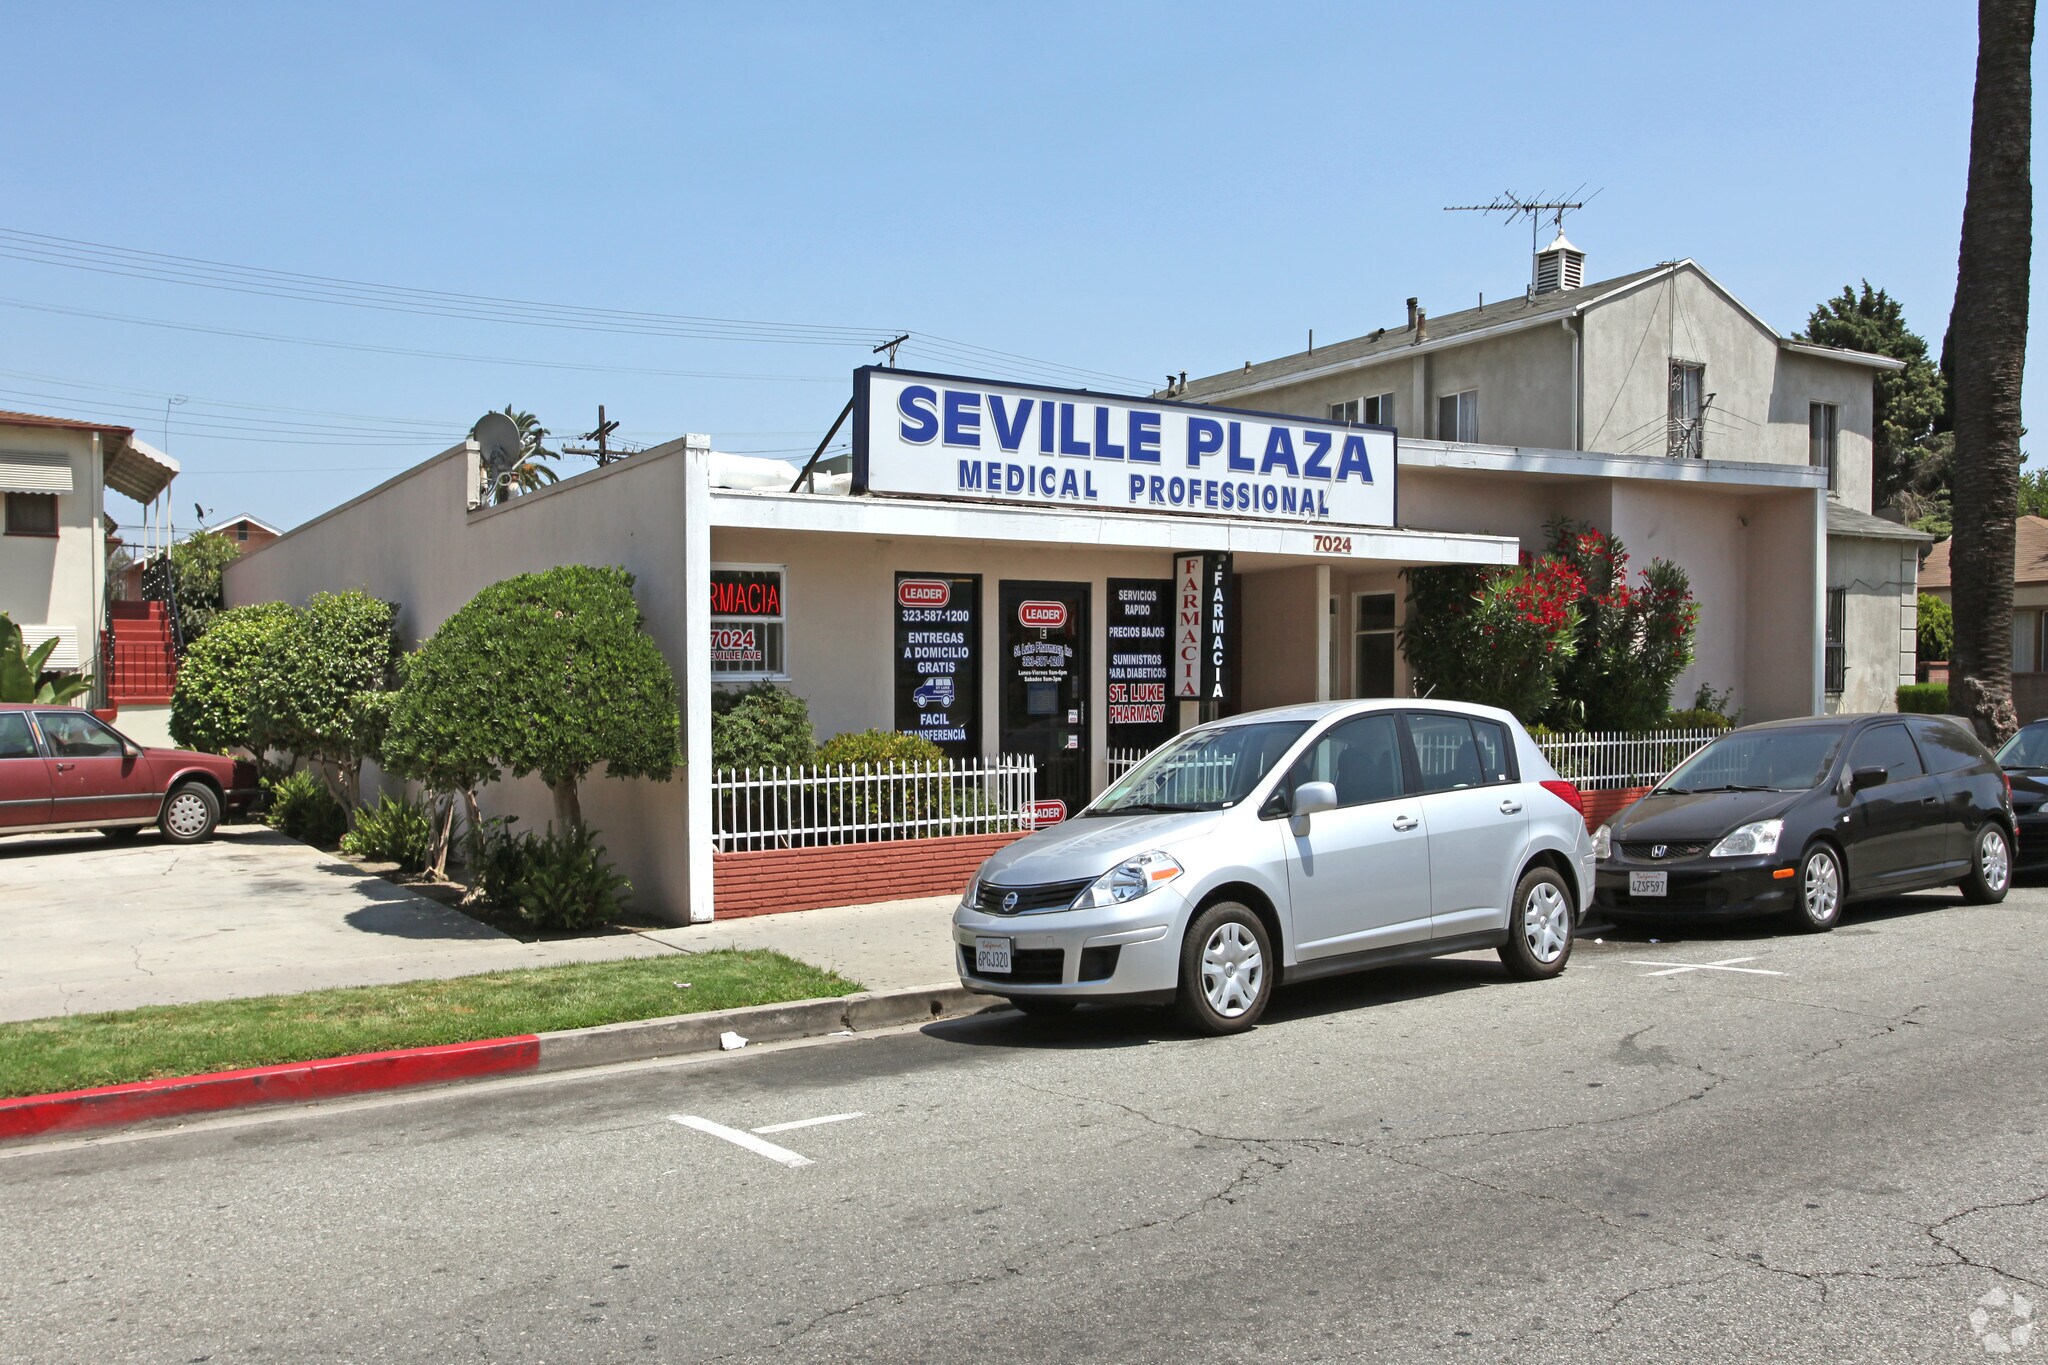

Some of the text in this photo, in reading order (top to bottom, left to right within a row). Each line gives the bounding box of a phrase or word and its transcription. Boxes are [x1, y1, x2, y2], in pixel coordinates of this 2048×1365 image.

[898, 385, 1374, 484] SEVILLE PLAZA
[958, 459, 1330, 518] MEDICAL PROFESSIONAL
[1314, 535, 1352, 553] 7024
[905, 588, 943, 599] LEADER
[1118, 589, 1157, 601] SERVICIOS
[1026, 609, 1060, 620] LEADER
[1125, 604, 1150, 615] RAPIDO
[902, 610, 969, 622] 323-587-1200
[1109, 626, 1165, 638] PRECIOS BAJOS
[1180, 560, 1200, 695] FARMACIA
[711, 629, 755, 649] 7024
[908, 632, 964, 644] ENTREGAS
[1212, 571, 1224, 698] FARMACIA
[742, 650, 761, 660] AVE
[904, 647, 969, 659] A DOMICILIO
[1112, 654, 1162, 665] SUMINISTROS
[917, 661, 956, 673] GRATIS
[1126, 667, 1167, 678] DIABETICOS
[1109, 683, 1165, 702] ST. LUKE
[920, 713, 949, 725] FACIL
[1109, 704, 1166, 724] PHARMACY
[1632, 880, 1665, 893] 4ZSF597
